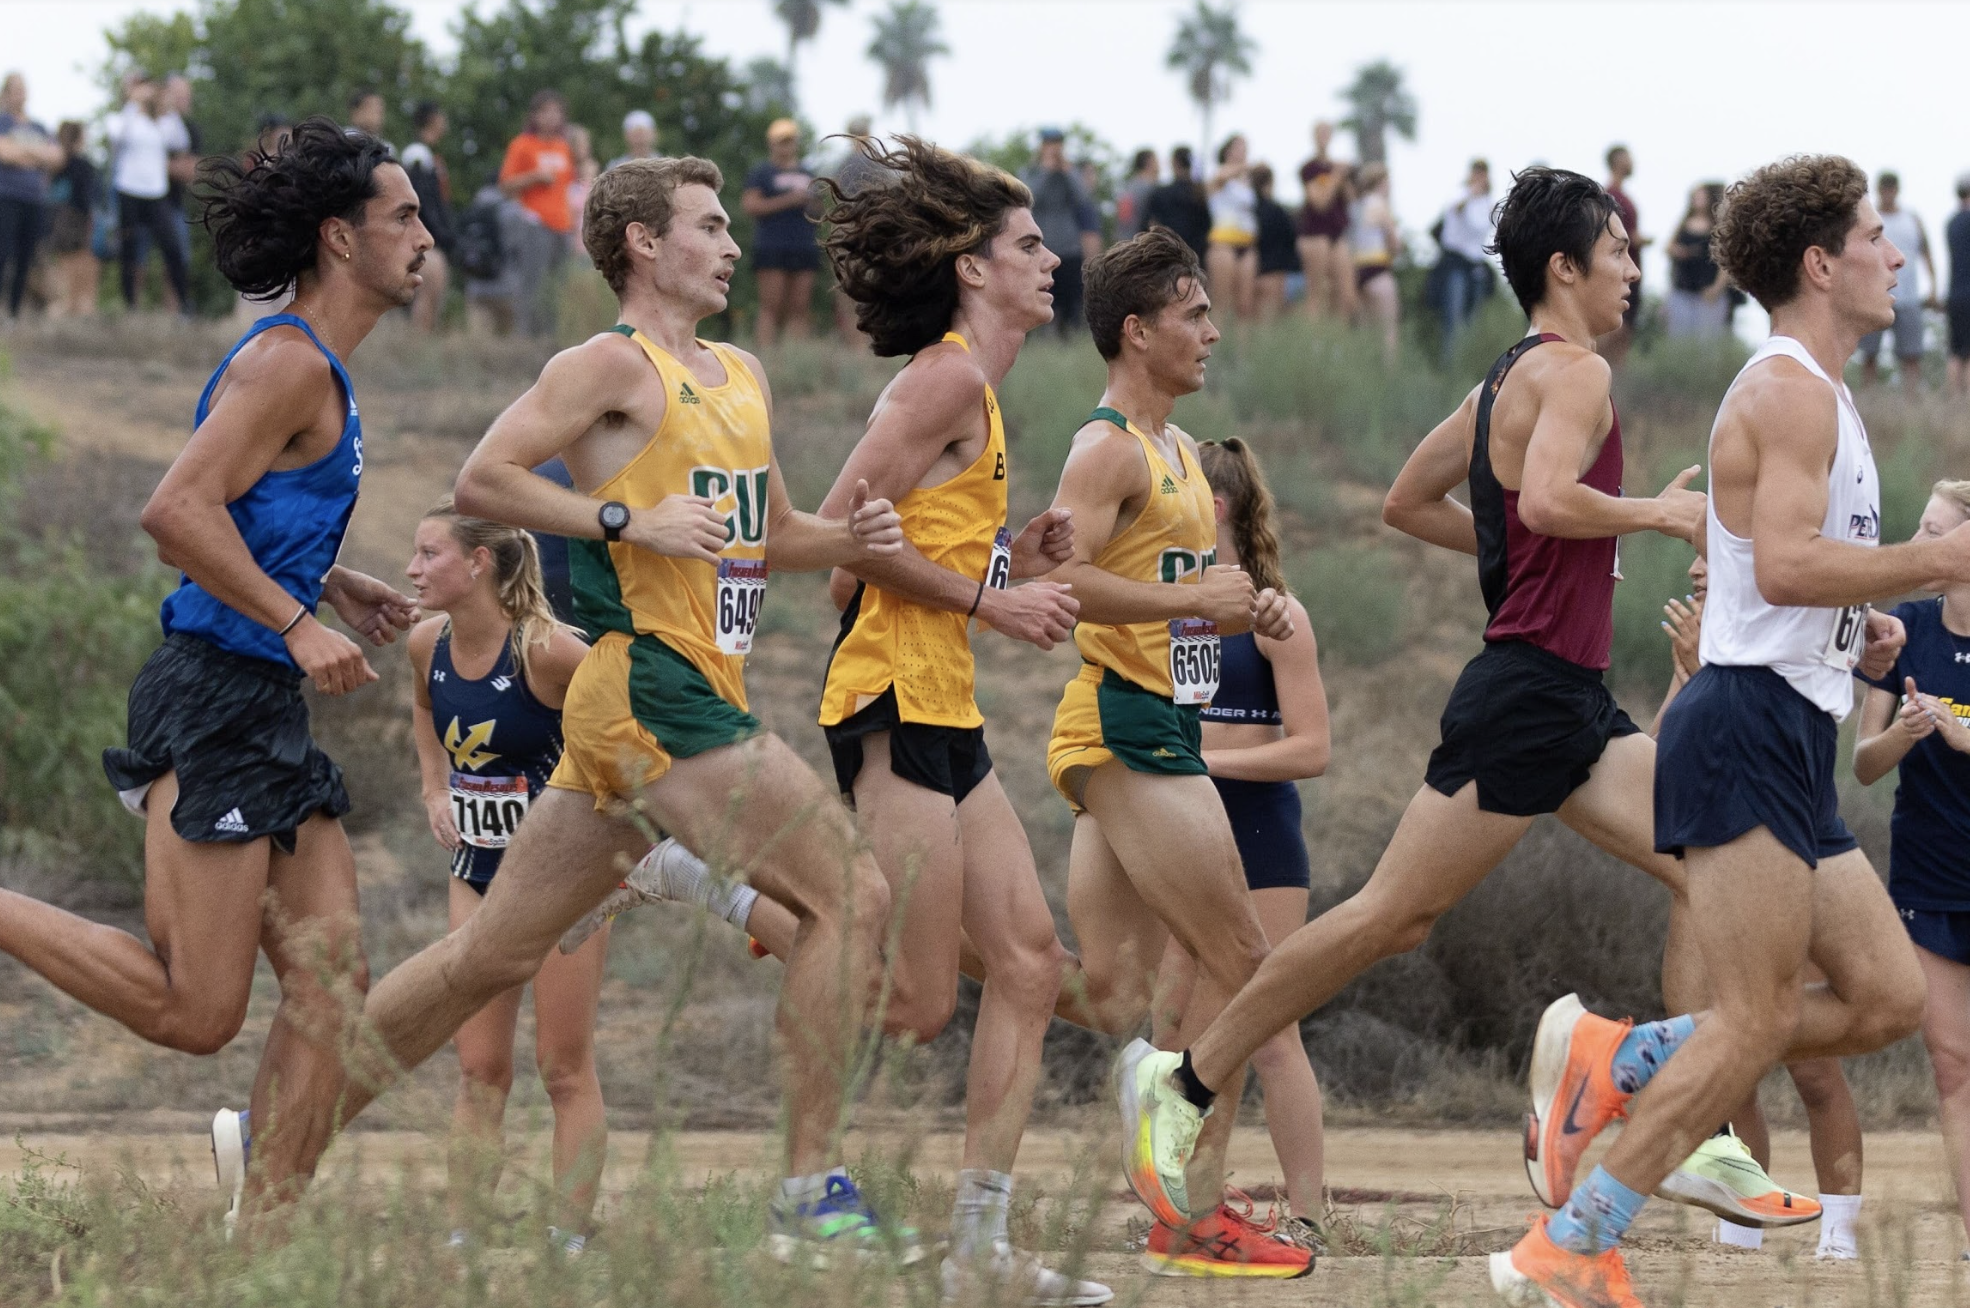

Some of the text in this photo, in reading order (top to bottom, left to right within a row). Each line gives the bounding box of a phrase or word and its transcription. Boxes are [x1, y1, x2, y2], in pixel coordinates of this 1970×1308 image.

[679, 396, 701, 405] adas
[1172, 642, 1221, 686] 6505
[214, 821, 250, 833] adidas
[452, 794, 525, 837] 7140
